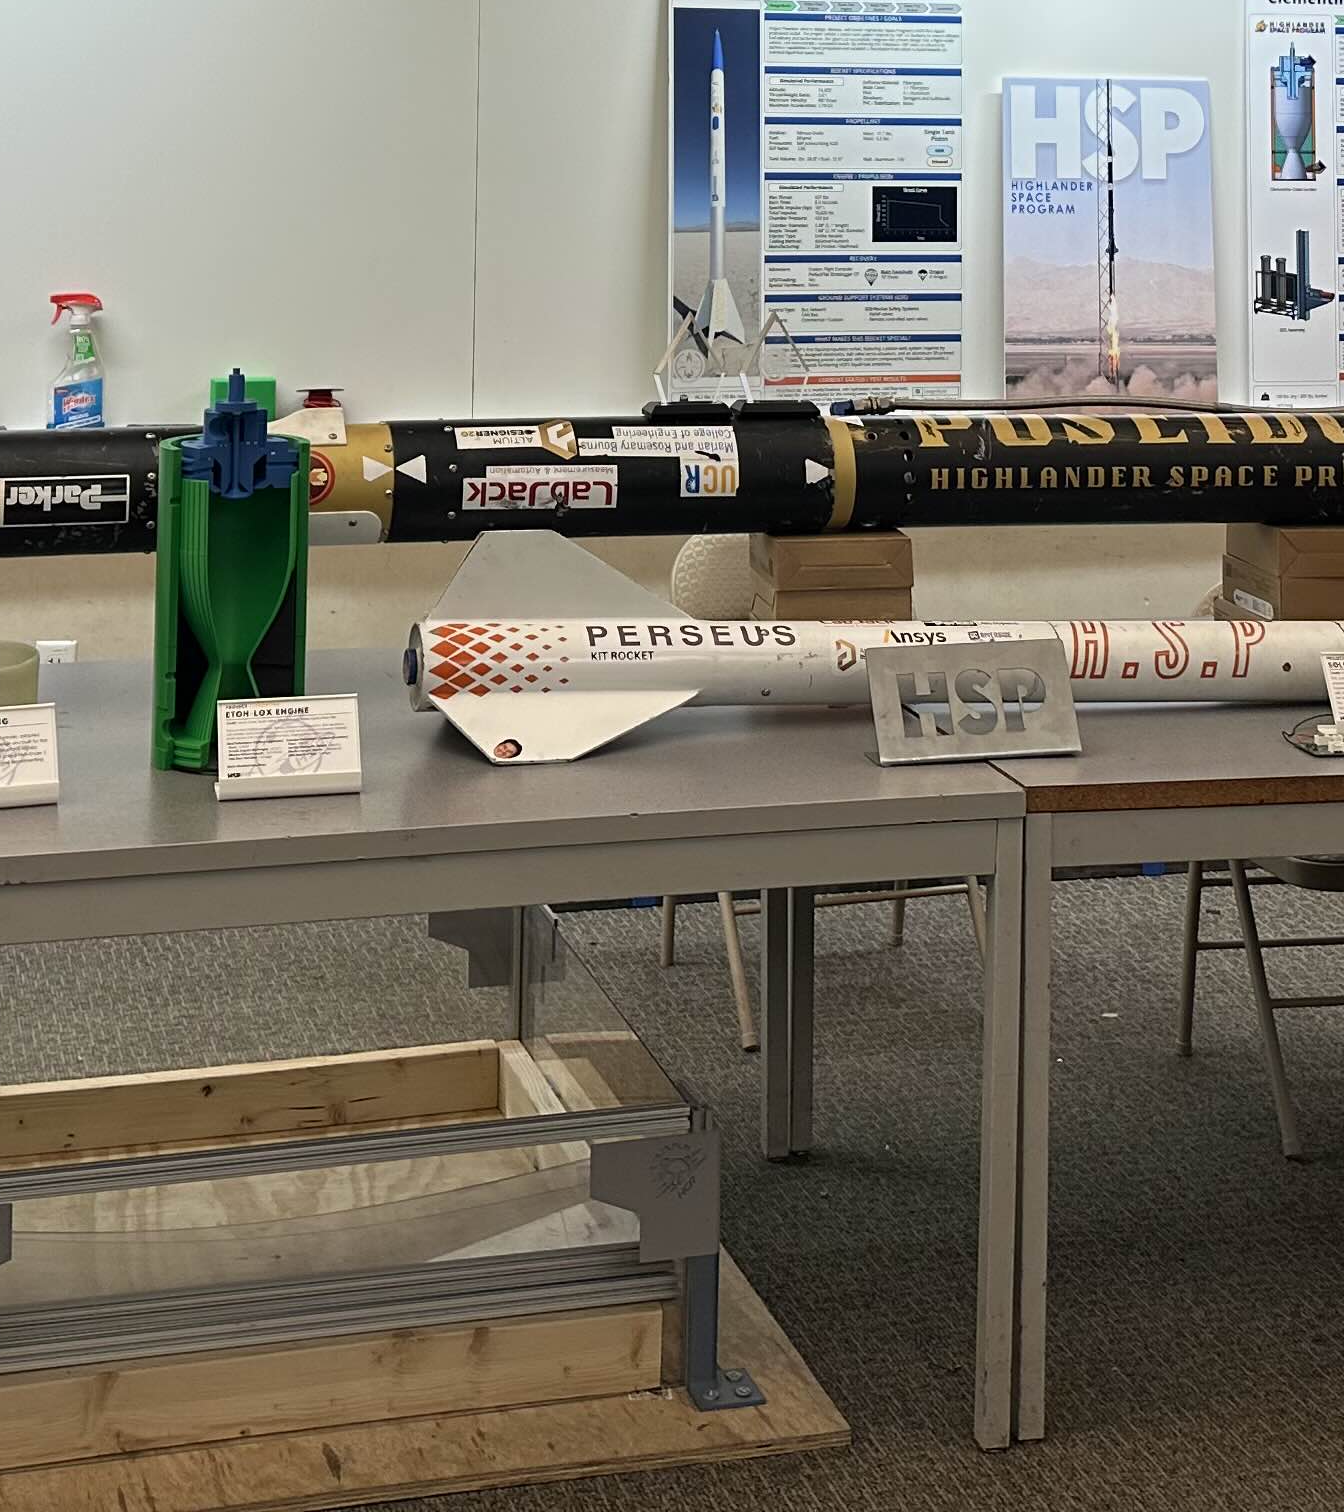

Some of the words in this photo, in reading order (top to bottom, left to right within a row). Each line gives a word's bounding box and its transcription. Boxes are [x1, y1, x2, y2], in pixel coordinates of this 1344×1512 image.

[1010, 84, 1204, 182] HSP
[1011, 180, 1093, 192] HIGHLANDER
[1011, 192, 1051, 203] SPACE
[1011, 204, 1076, 215] PROGRAM
[615, 427, 678, 439] Engineering
[680, 427, 690, 439] of
[693, 427, 732, 439] College
[493, 437, 533, 445] ALTIUM
[580, 441, 618, 453] Bourns
[620, 439, 672, 453] Rosemary
[675, 441, 694, 453] and
[696, 441, 734, 453] Marian
[489, 467, 541, 475] Automation
[544, 467, 551, 475] &
[553, 467, 614, 475] Measurement
[684, 464, 736, 496] UCR
[930, 465, 1154, 490] HIGHLANDER
[1168, 465, 1278, 489] SPACE
[5, 483, 103, 510] Parker
[466, 481, 613, 507] LabJack
[585, 625, 797, 647] PERSEUS
[882, 629, 947, 645] Ansys
[591, 651, 607, 661] KIT
[611, 650, 654, 661] ROCKET
[900, 668, 1047, 737] HSP
[254, 708, 273, 717] LOX
[275, 706, 309, 716] ENGINE
